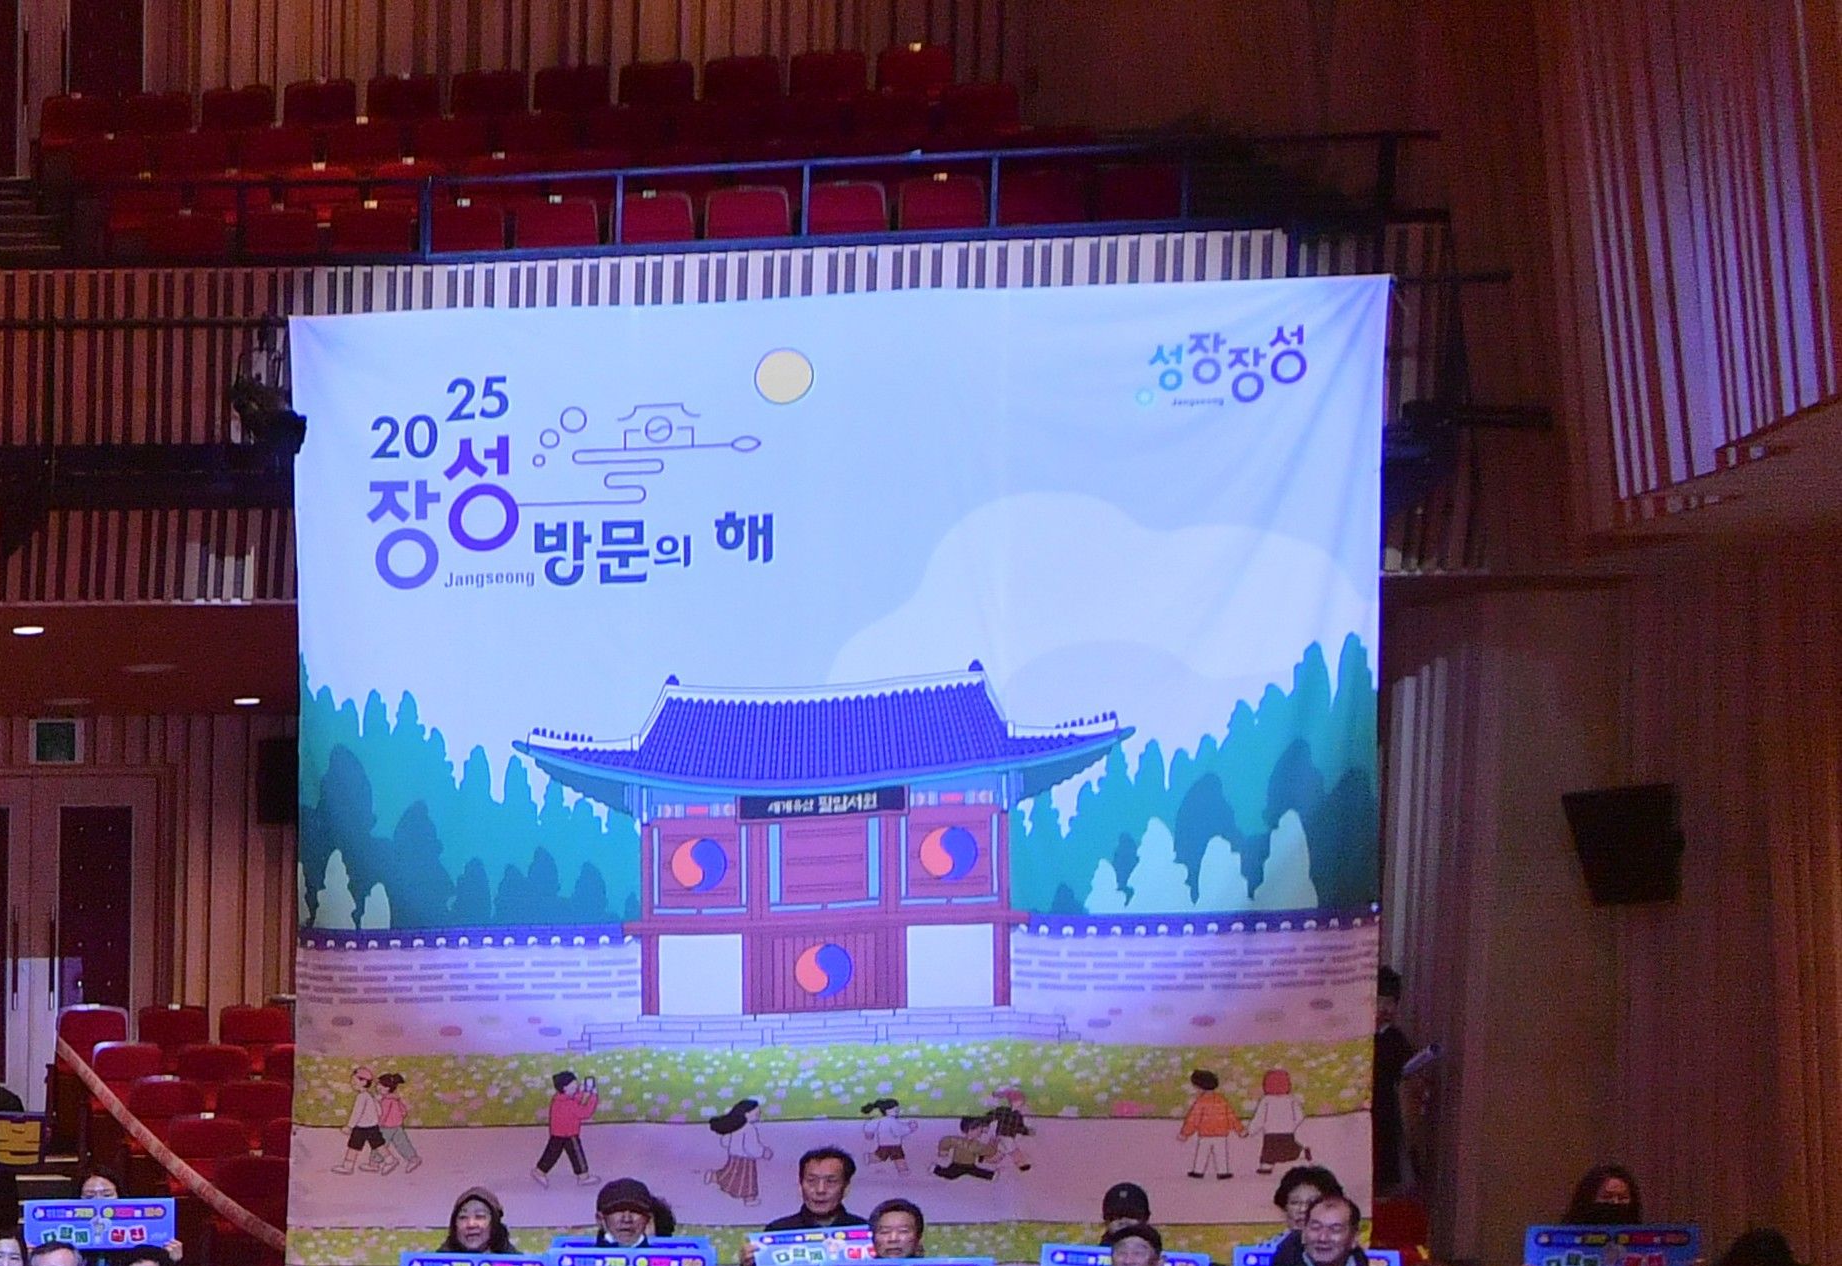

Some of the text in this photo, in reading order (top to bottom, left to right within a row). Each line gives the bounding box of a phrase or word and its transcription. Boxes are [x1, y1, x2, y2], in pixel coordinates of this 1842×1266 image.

[367, 435, 774, 590] 장성 방문의 해
[444, 570, 535, 589] Jangseong
